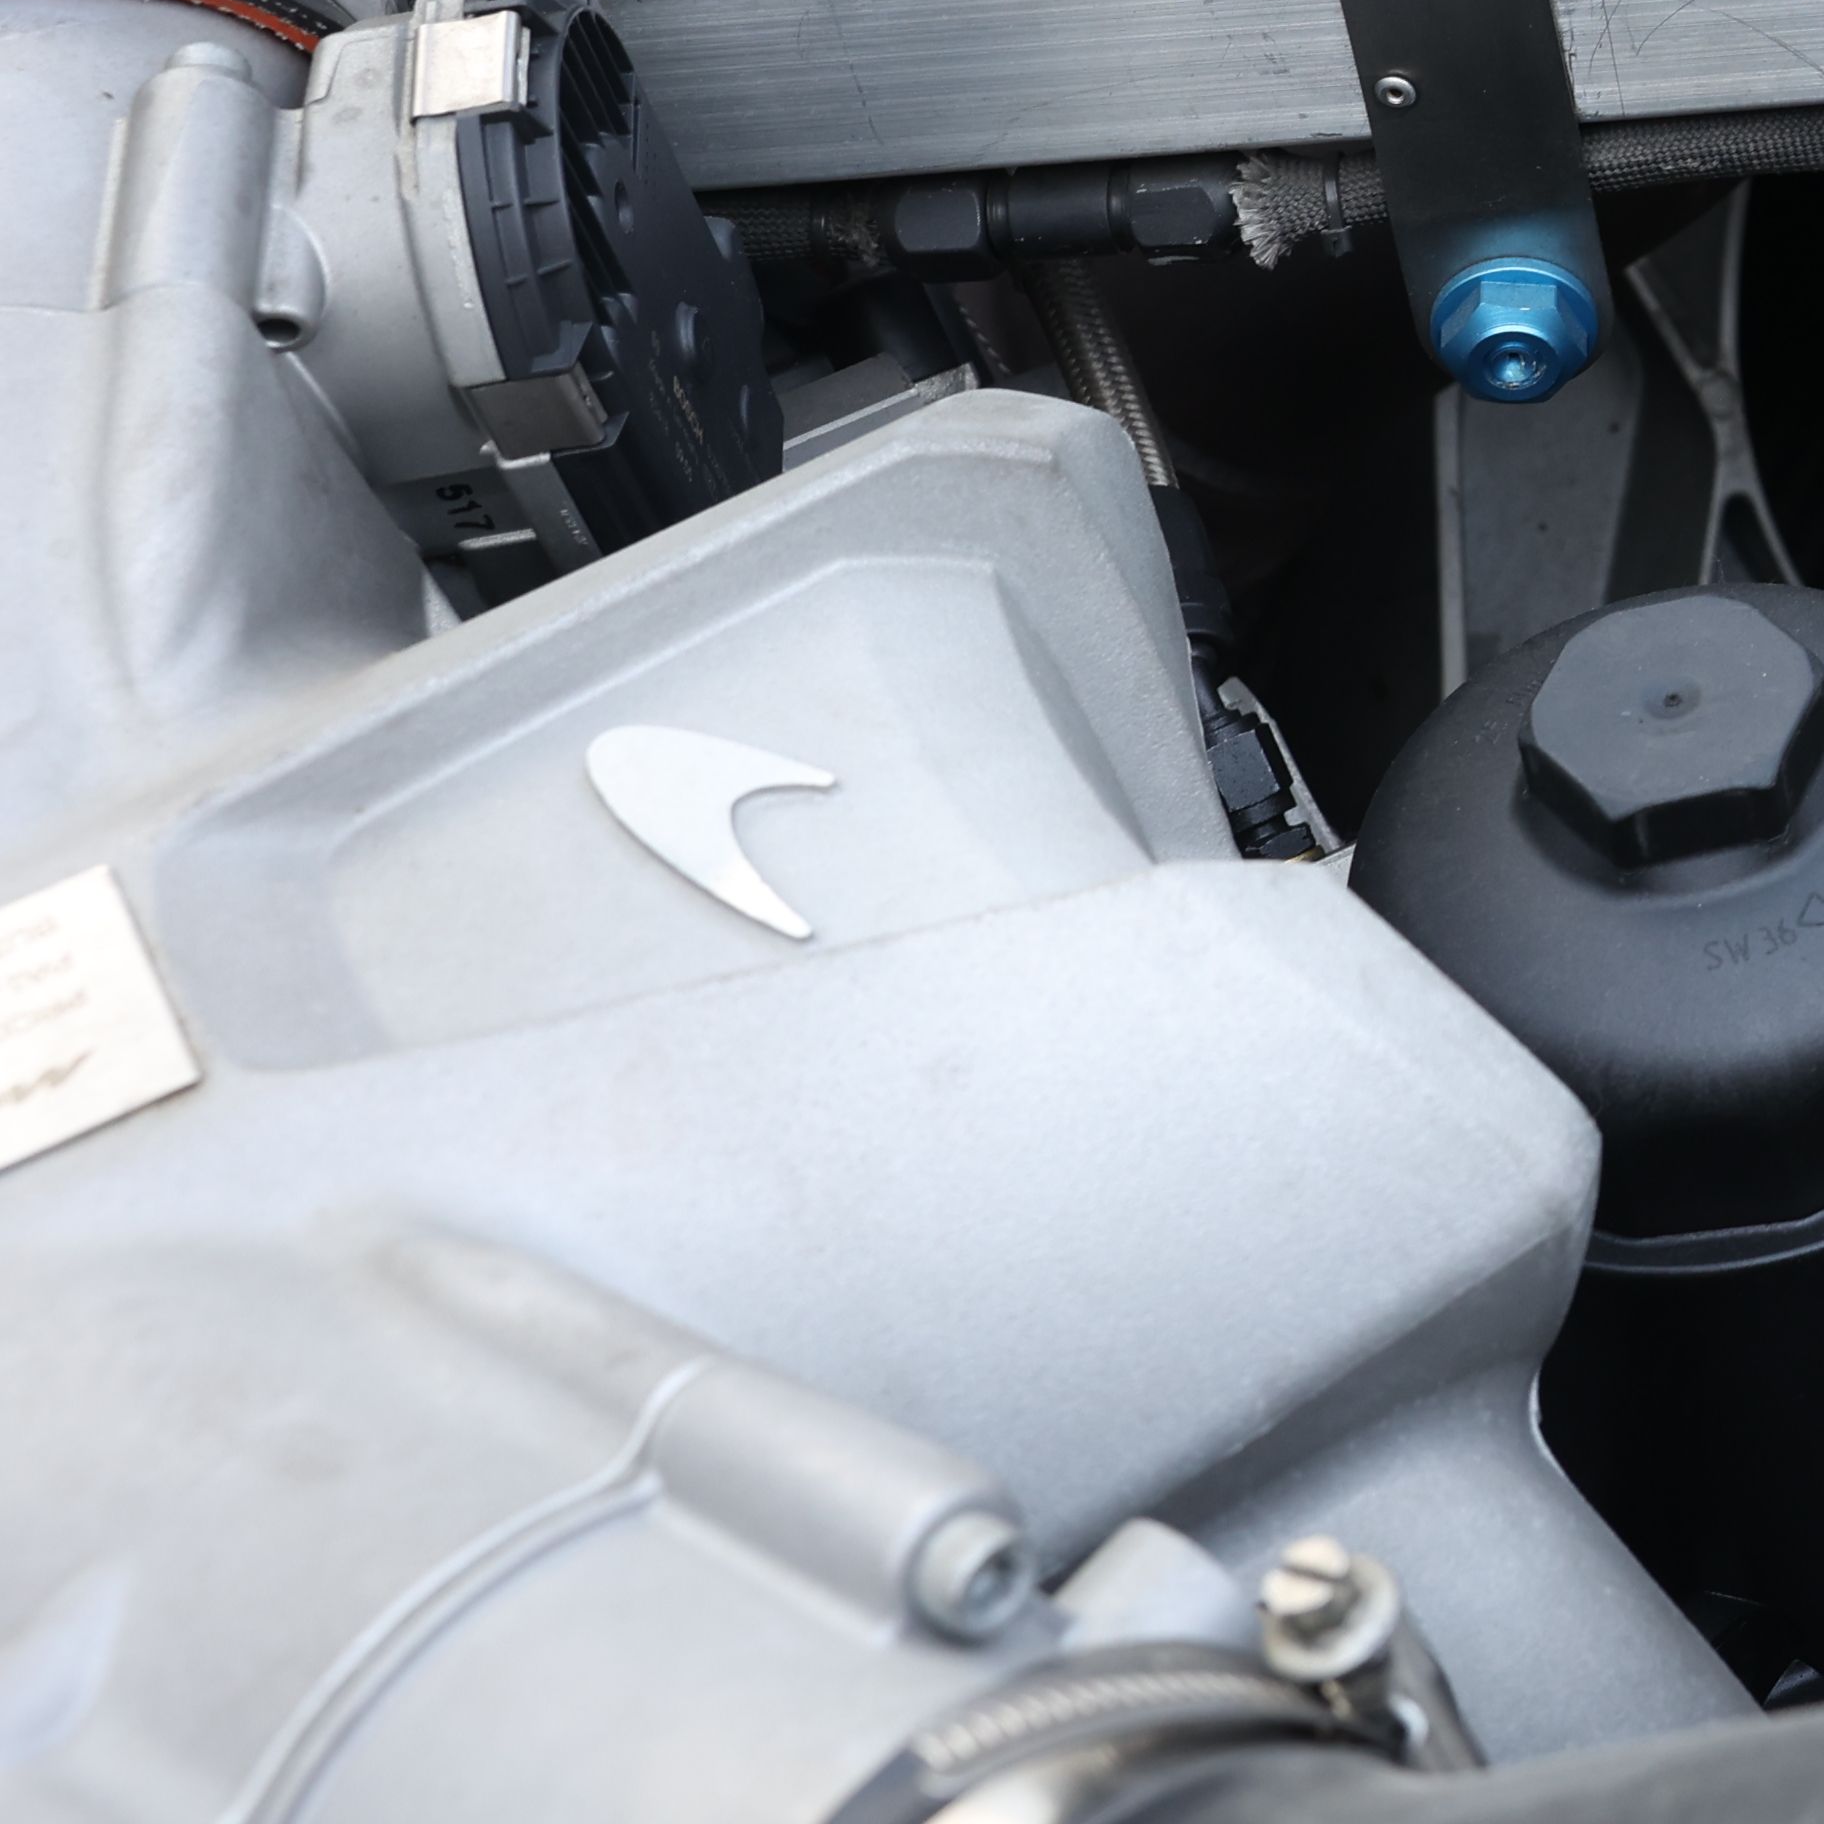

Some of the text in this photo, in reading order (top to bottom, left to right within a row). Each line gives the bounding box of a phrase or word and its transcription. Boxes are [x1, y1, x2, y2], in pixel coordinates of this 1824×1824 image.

[435, 483, 496, 531] 517
[1703, 933, 1750, 972] SW
[1758, 918, 1798, 955] 36
